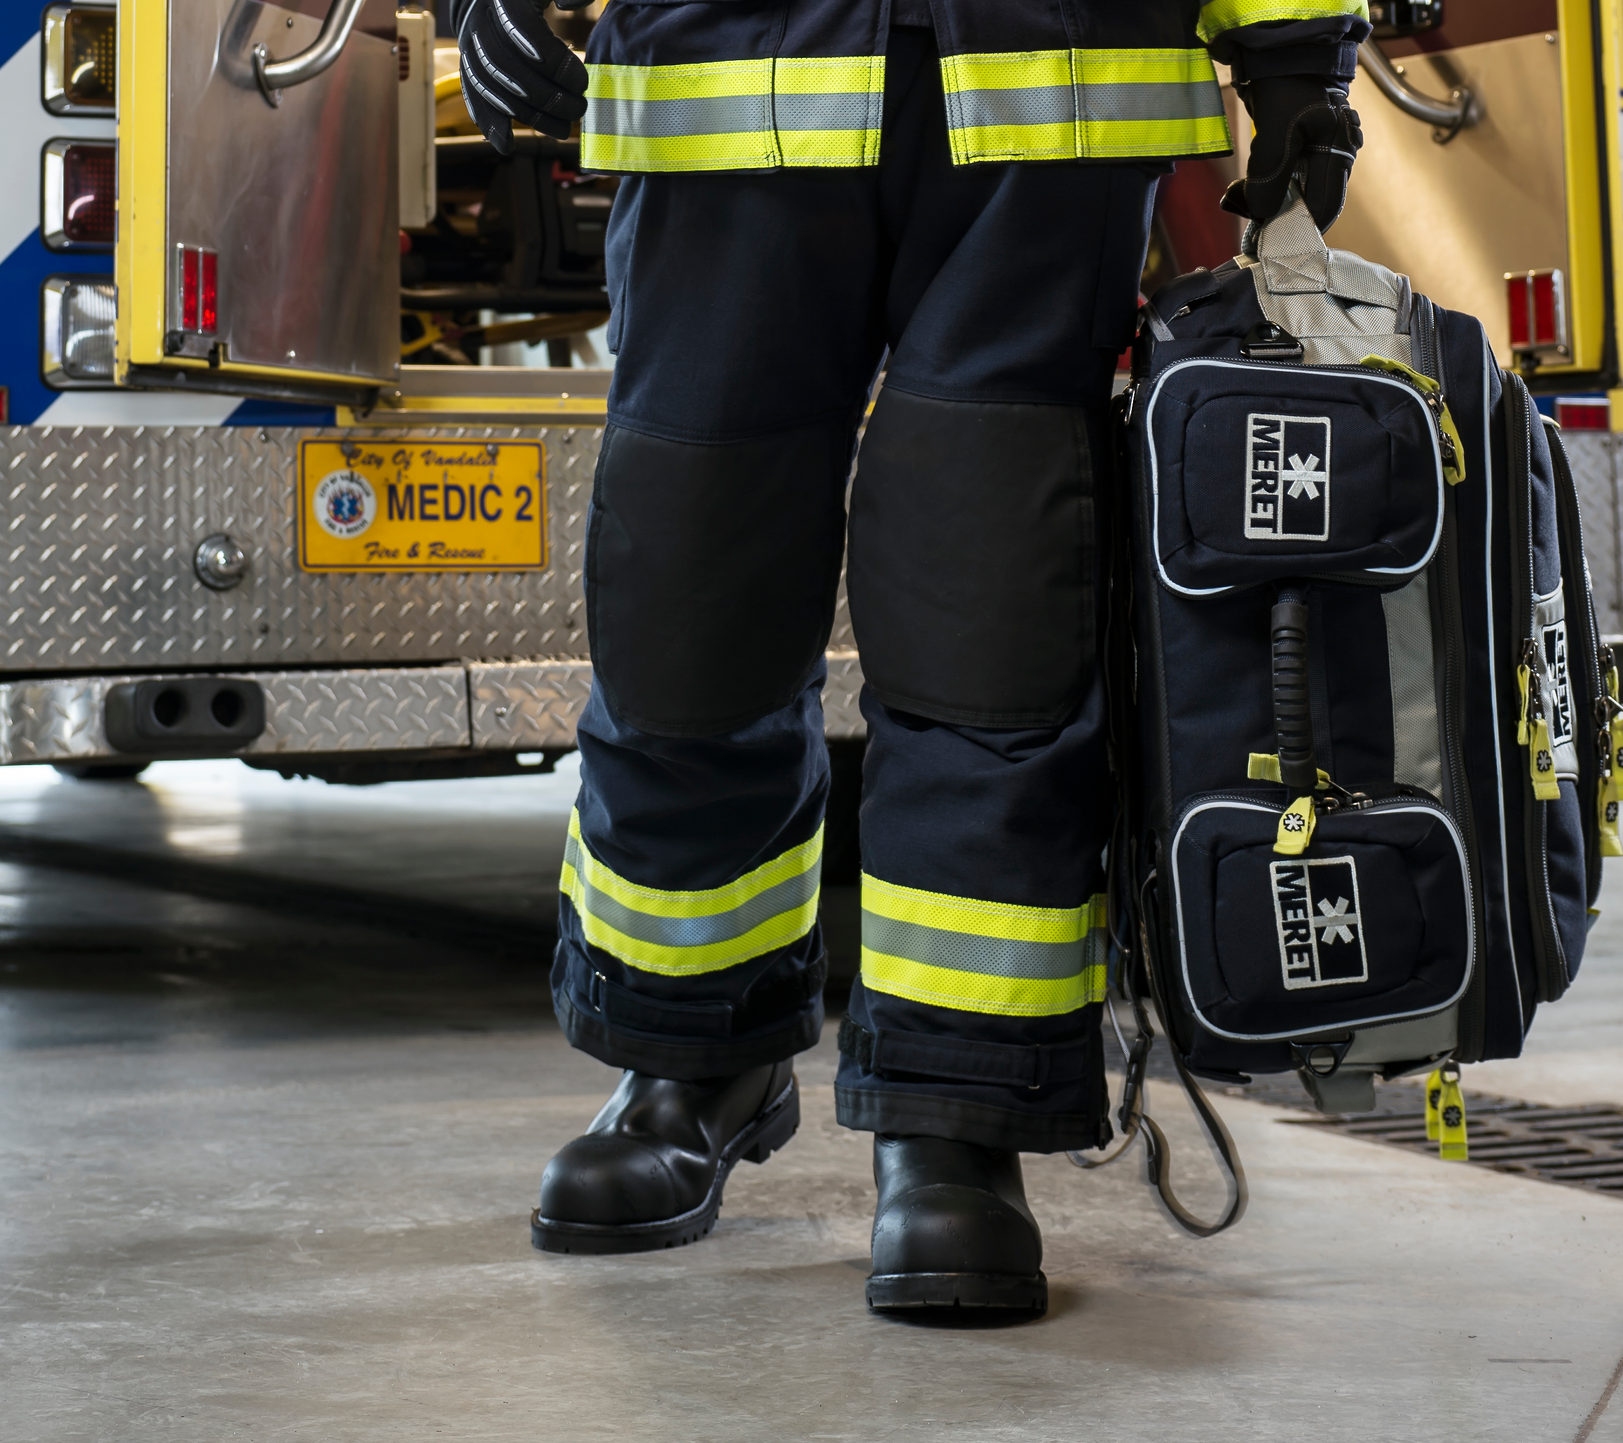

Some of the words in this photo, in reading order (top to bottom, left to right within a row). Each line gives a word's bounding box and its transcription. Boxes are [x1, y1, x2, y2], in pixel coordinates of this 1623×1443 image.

[347, 448, 385, 468] City
[392, 449, 413, 469] Of
[1250, 417, 1281, 534] MERET
[387, 484, 502, 522] MEDIC
[514, 485, 533, 521] 2
[364, 541, 400, 561] Fire
[406, 541, 420, 558] &
[428, 541, 486, 559] Rescue
[1557, 627, 1571, 736] MERET
[1275, 864, 1317, 982] MERET
